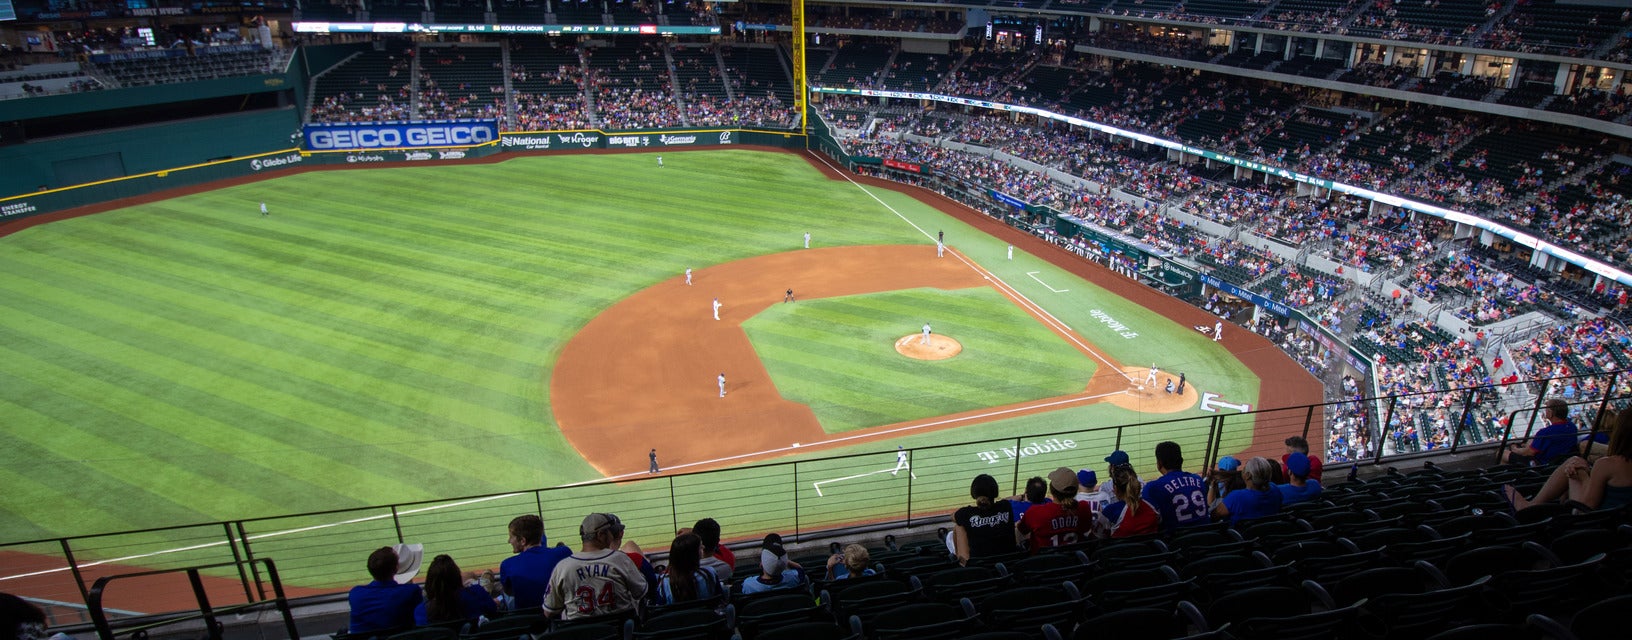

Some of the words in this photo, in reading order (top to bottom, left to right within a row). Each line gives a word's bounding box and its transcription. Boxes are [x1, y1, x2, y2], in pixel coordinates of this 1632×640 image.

[310, 129, 401, 148] GEICO
[406, 126, 492, 145] GEICO
[512, 136, 550, 146] National
[571, 132, 598, 148] Kroger
[262, 157, 287, 168] Globe
[286, 154, 302, 164] Life
[2, 202, 28, 212] ENERGY
[4, 206, 36, 216] TRANSFER
[1170, 266, 1186, 278] Medical
[1206, 276, 1220, 288] Mitel
[1238, 290, 1252, 300] Mitel
[1272, 304, 1288, 316] Mitel
[1000, 438, 1078, 460] Mobile
[1164, 476, 1201, 494] BELTRE
[1172, 490, 1206, 522] 29
[1052, 516, 1079, 530] ODOR
[576, 564, 610, 581] RYAN
[575, 581, 617, 615] 34
